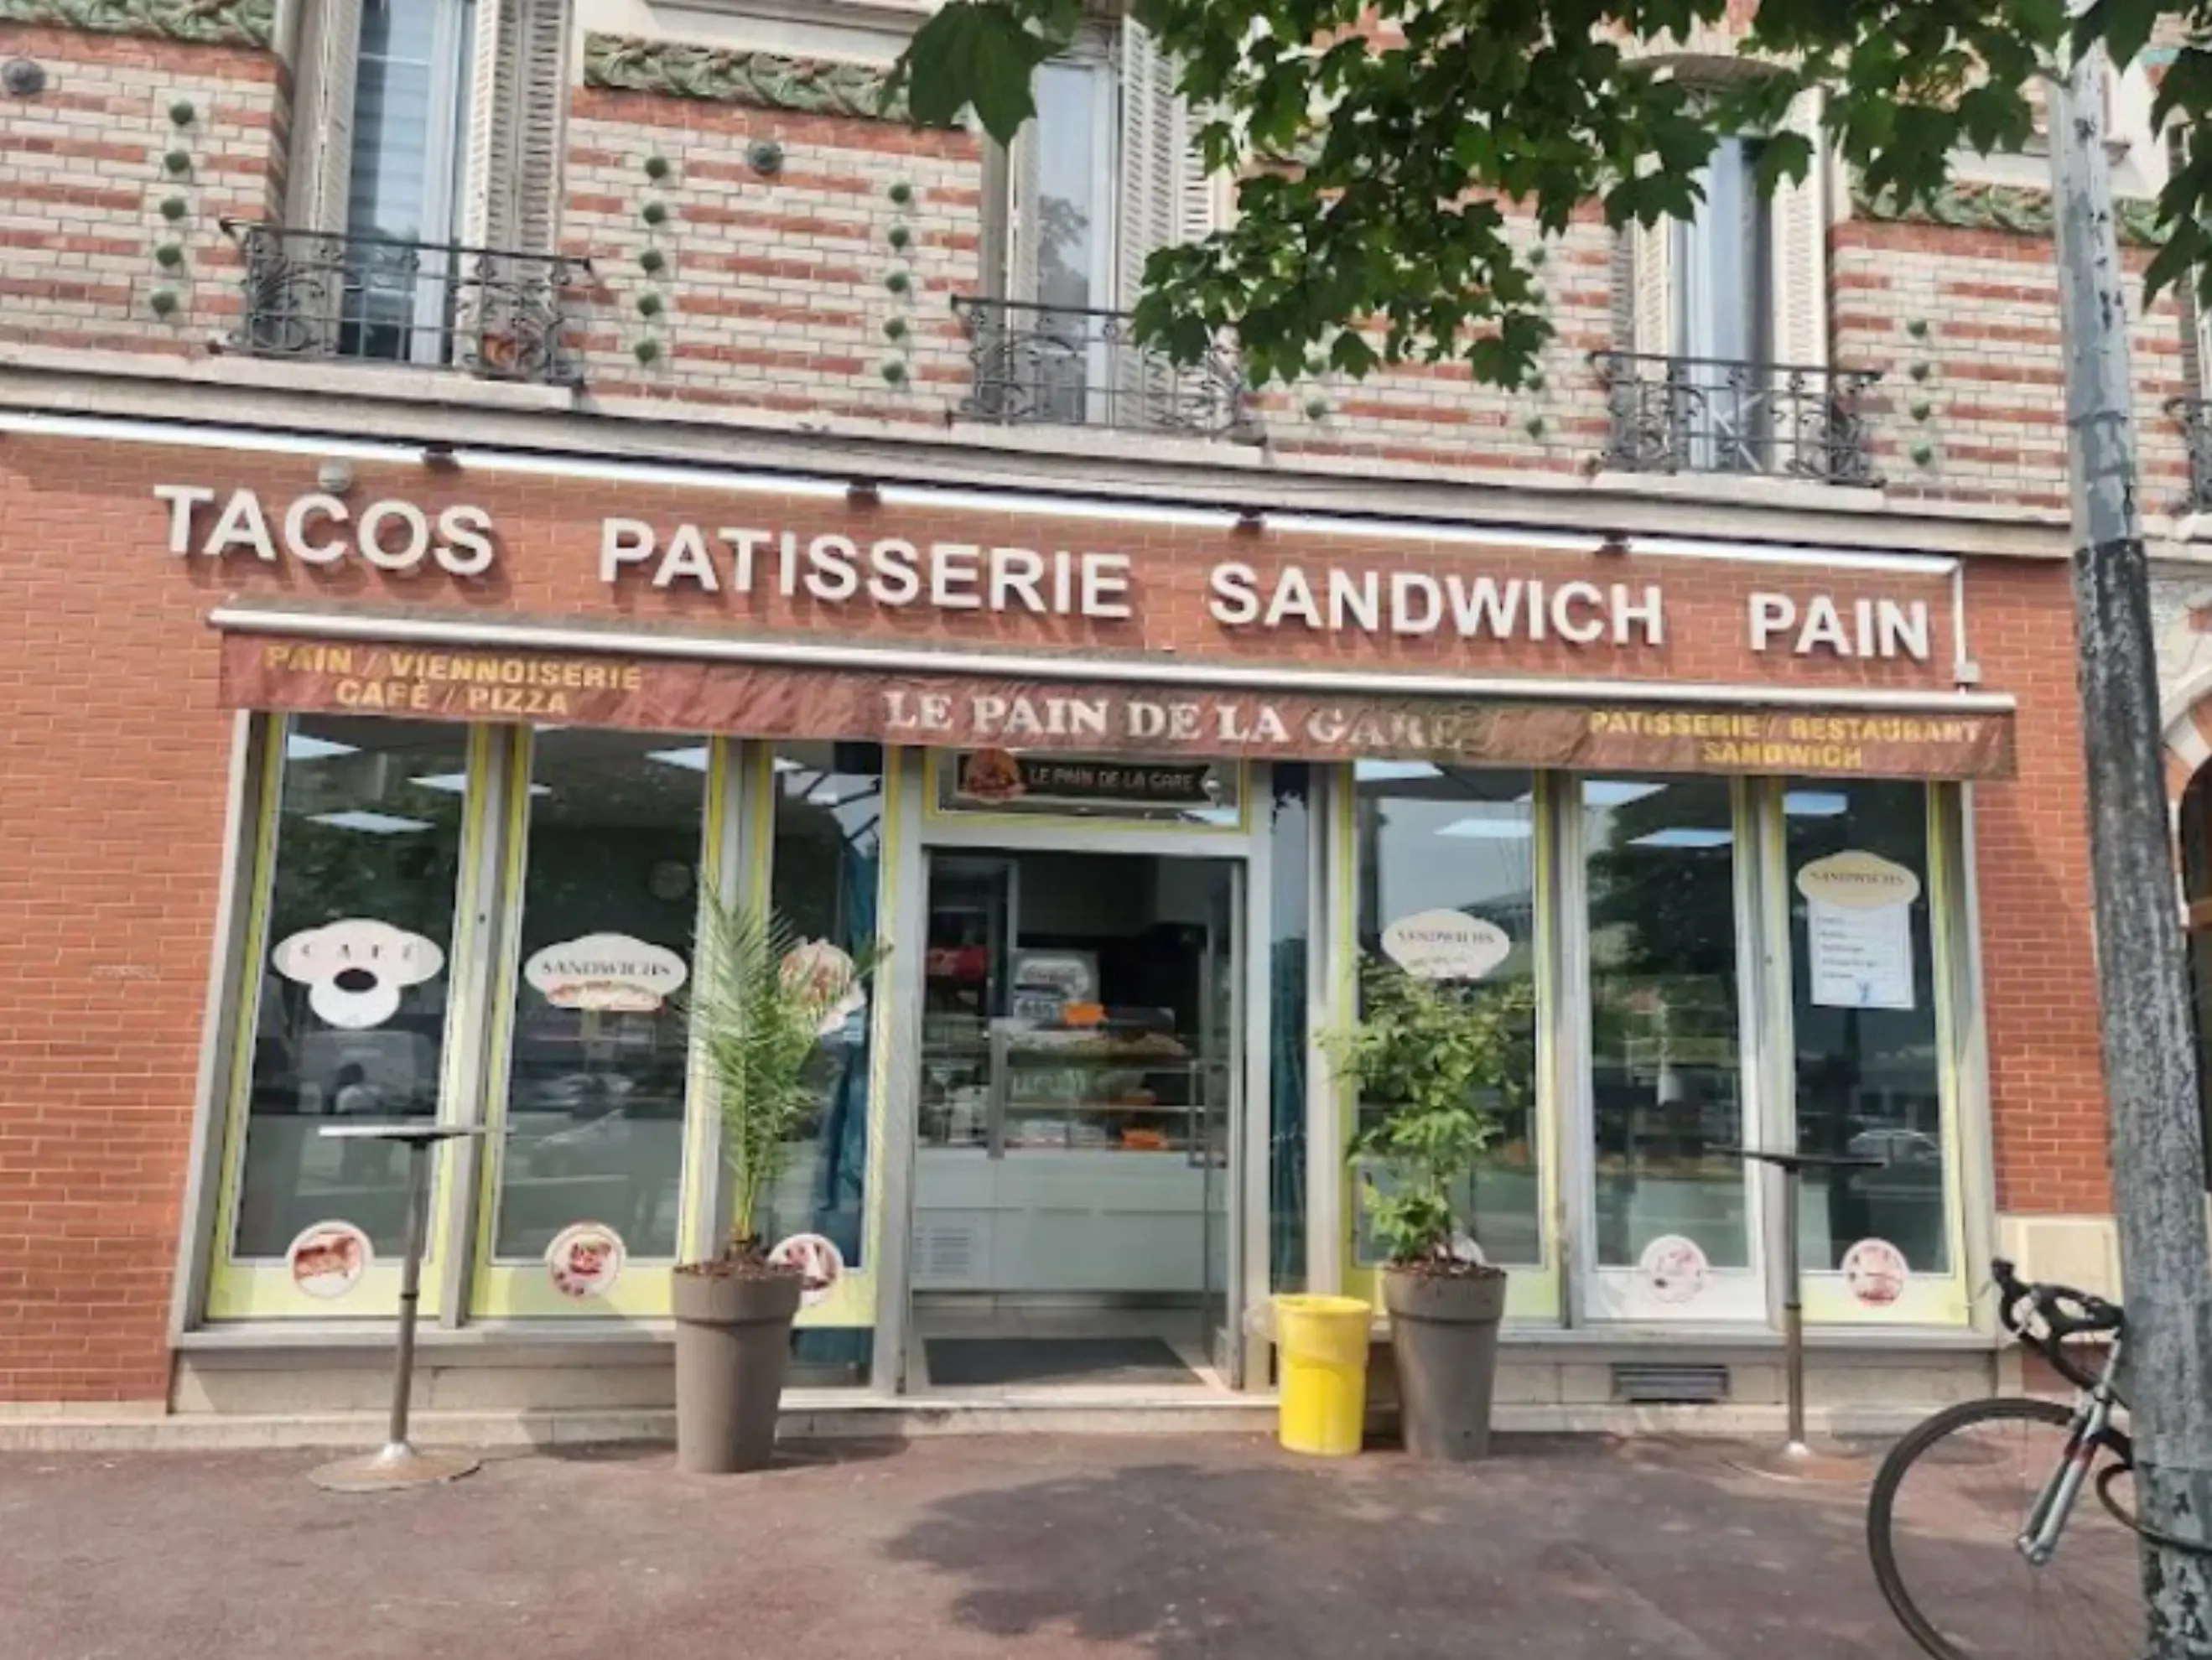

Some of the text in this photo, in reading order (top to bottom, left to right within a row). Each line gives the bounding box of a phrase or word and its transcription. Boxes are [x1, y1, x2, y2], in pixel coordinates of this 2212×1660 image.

[154, 485, 1929, 660] TACOS PATISSERIE SANDWICH PAIN
[264, 644, 352, 673] PAIN
[389, 652, 642, 689] VIENNOISERIE
[336, 678, 430, 709] CAFÉ
[469, 687, 569, 714] PIZZA
[883, 691, 1462, 749] LE PAIN DE LA GARE
[1590, 711, 1761, 738] PATISSERIE
[1789, 717, 1982, 743] RESTAURANT
[1703, 741, 1862, 769] SANDWICH
[1029, 768, 1050, 785] LE
[1054, 768, 1094, 787] PAIN
[1098, 770, 1117, 788] DE
[1122, 771, 1145, 790] LA
